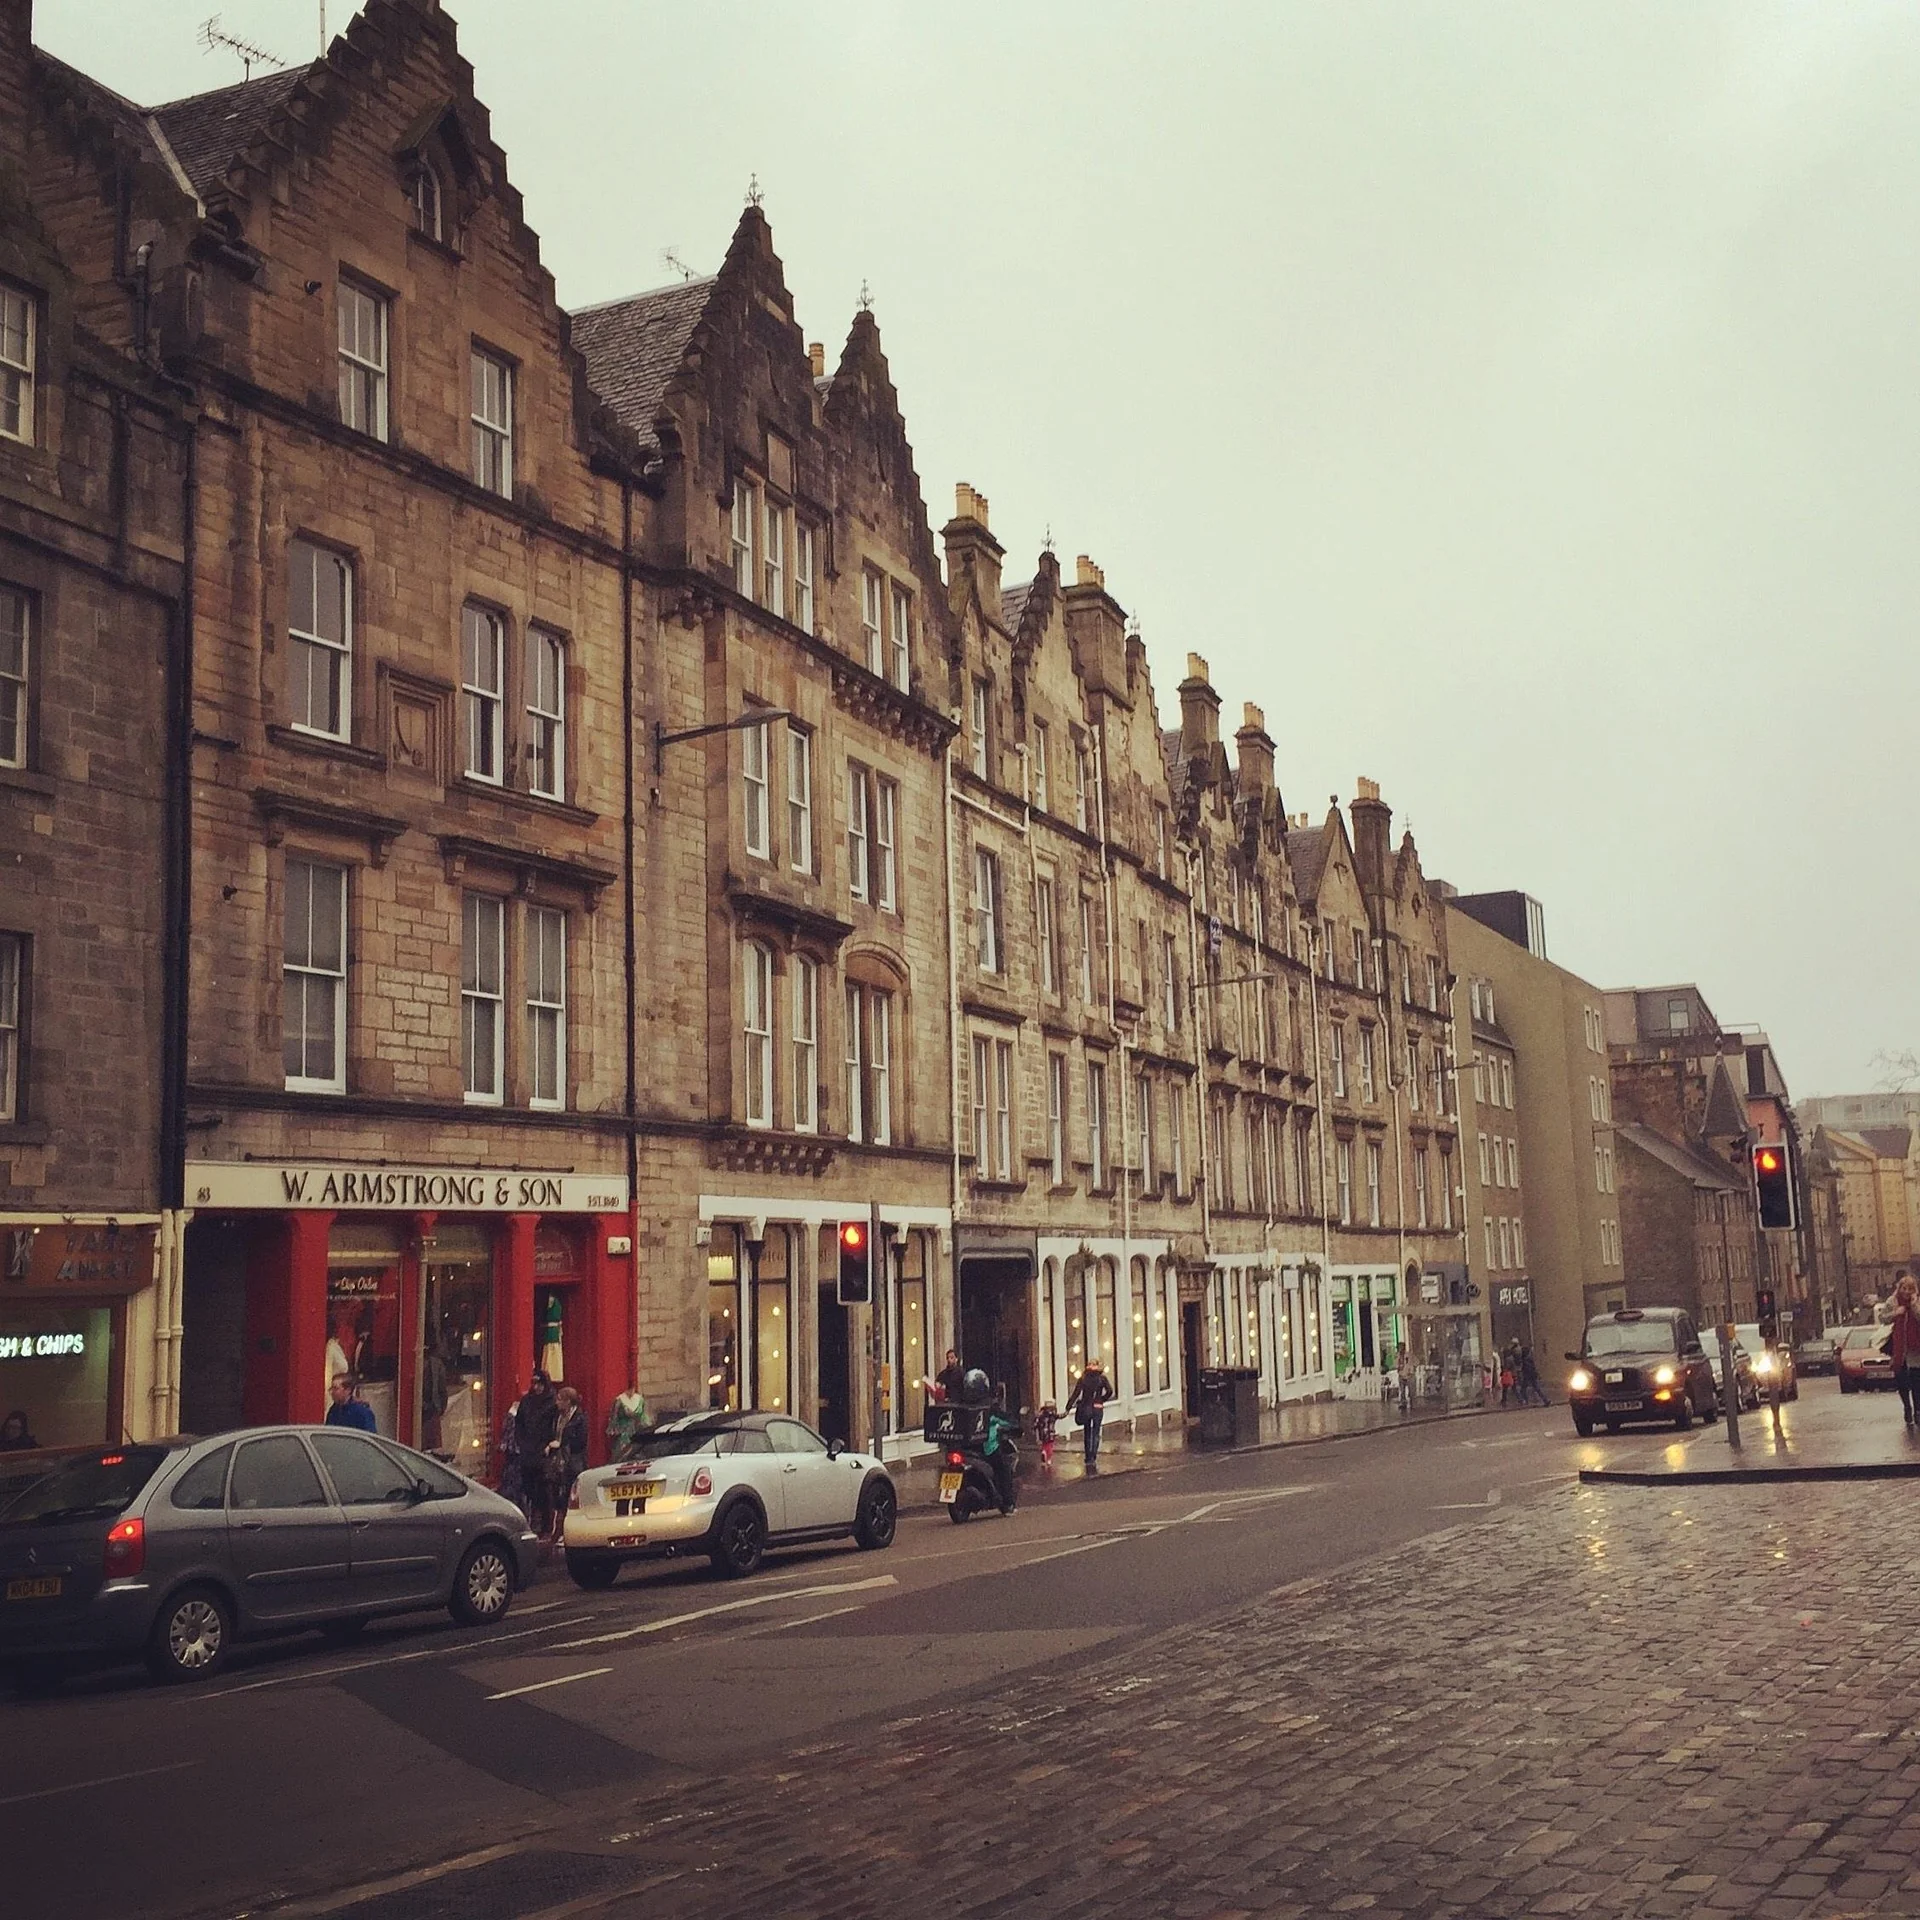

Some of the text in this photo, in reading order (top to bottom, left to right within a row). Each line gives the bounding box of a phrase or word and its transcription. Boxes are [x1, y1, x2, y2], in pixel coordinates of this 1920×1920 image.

[281, 1170, 562, 1207] W. ARMSTRONG & SON
[20, 1336, 32, 1357] &
[36, 1333, 84, 1356] CHIPS
[610, 1486, 635, 1498] SL63
